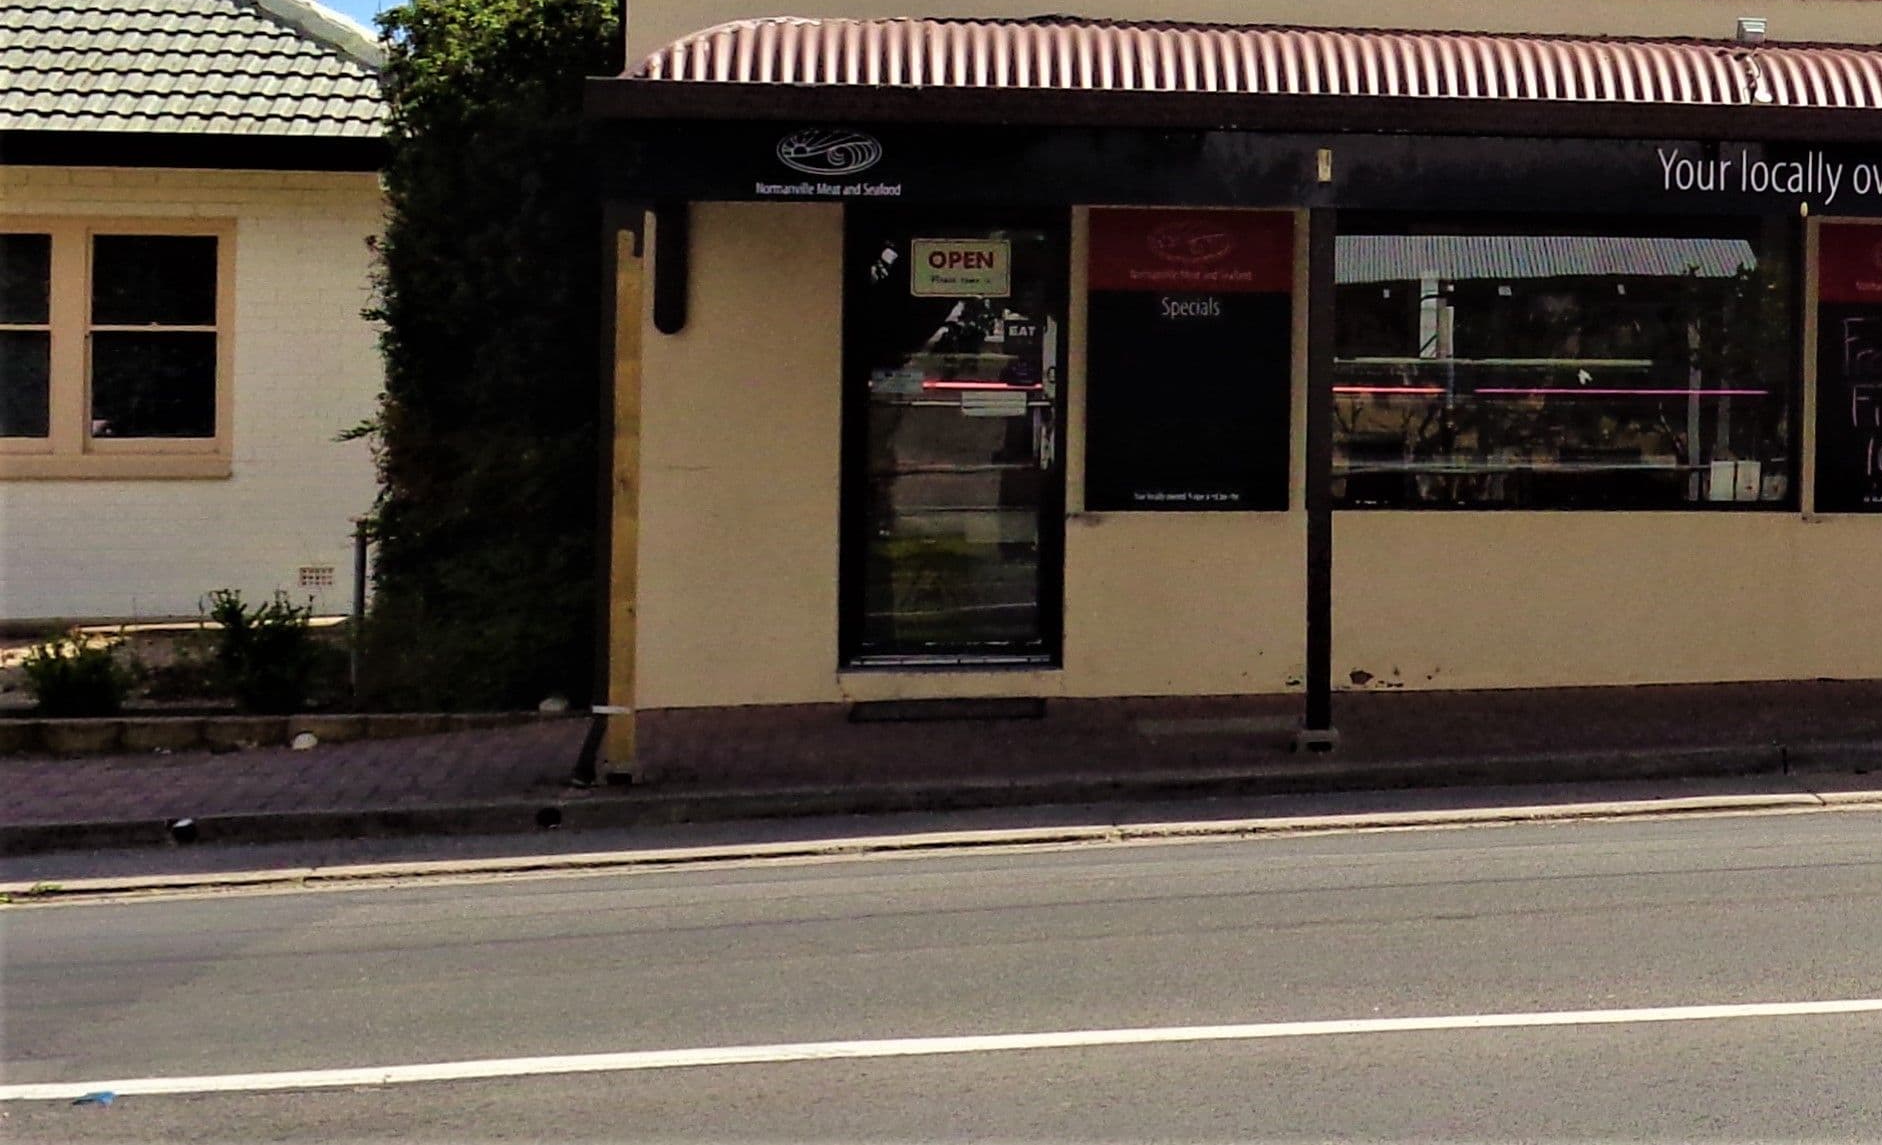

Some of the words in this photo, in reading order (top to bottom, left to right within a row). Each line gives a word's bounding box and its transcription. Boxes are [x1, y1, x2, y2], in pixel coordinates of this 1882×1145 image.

[1657, 148, 1738, 192] Your
[1741, 150, 1843, 205] locally
[755, 182, 815, 195] Normanville
[816, 183, 842, 196] Meat
[843, 183, 862, 196] and
[863, 183, 901, 196] Seafood
[928, 250, 994, 270] OPEN
[1161, 297, 1221, 319] Specials
[1008, 325, 1037, 337] EAT
